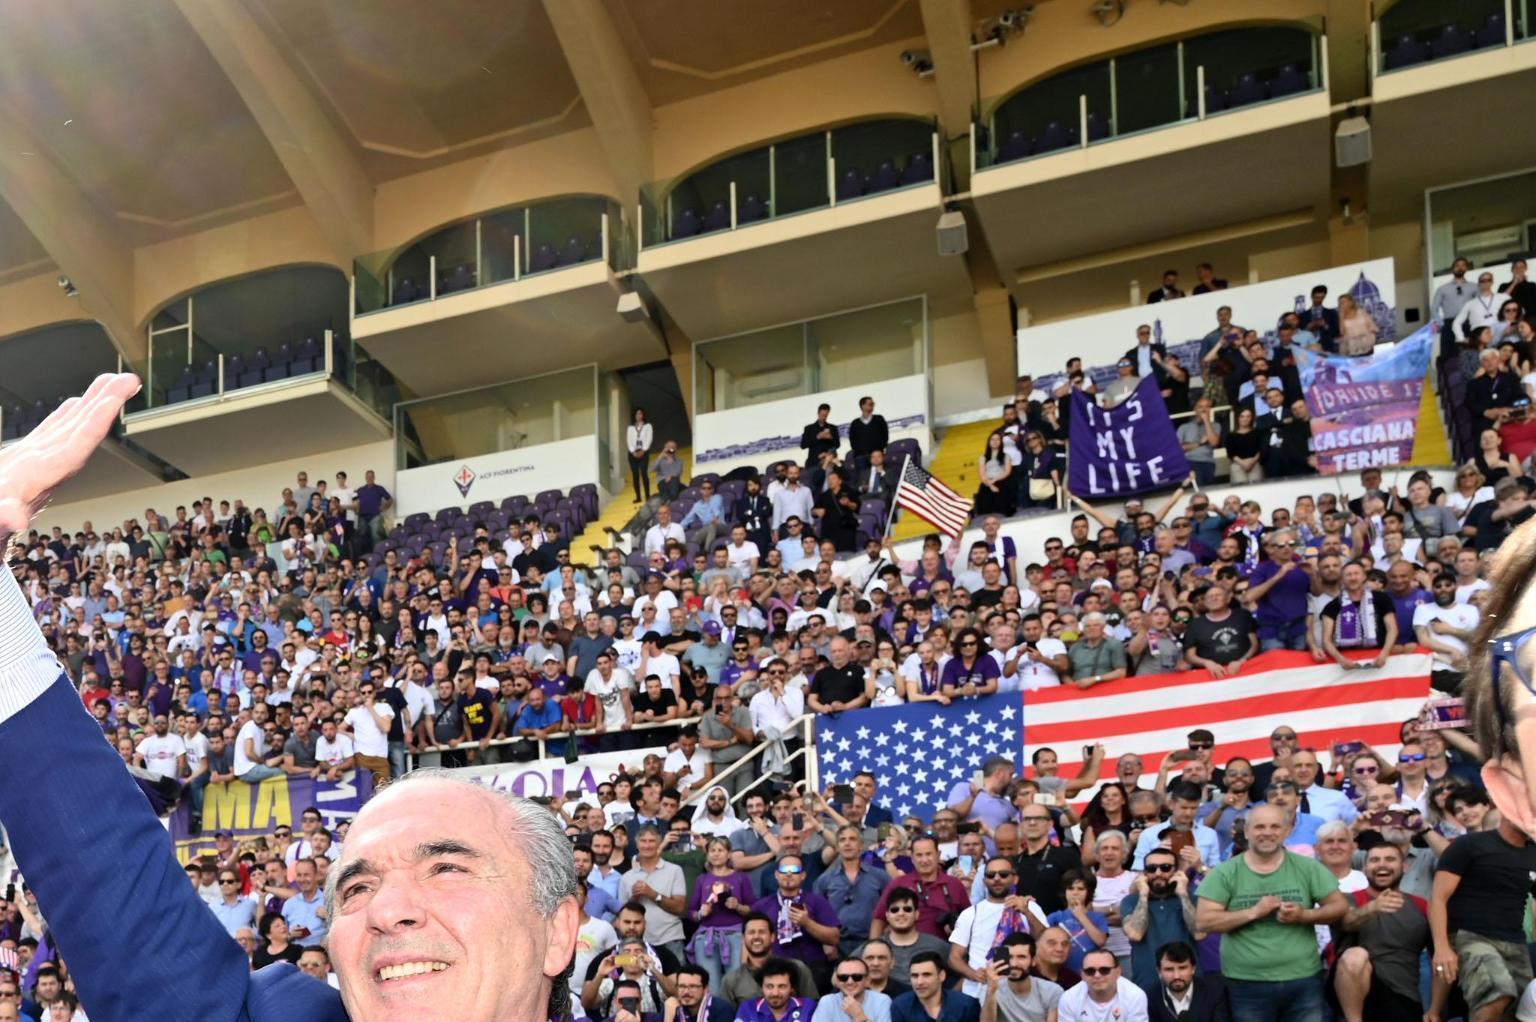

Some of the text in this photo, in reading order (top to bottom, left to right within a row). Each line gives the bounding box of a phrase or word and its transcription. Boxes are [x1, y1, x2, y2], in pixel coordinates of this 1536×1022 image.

[1324, 384, 1392, 409] DAVIDE
[1096, 426, 1136, 460] MY
[1313, 419, 1414, 452] CASCIANA
[1088, 455, 1169, 494] LIFE
[1332, 446, 1400, 473] TERME
